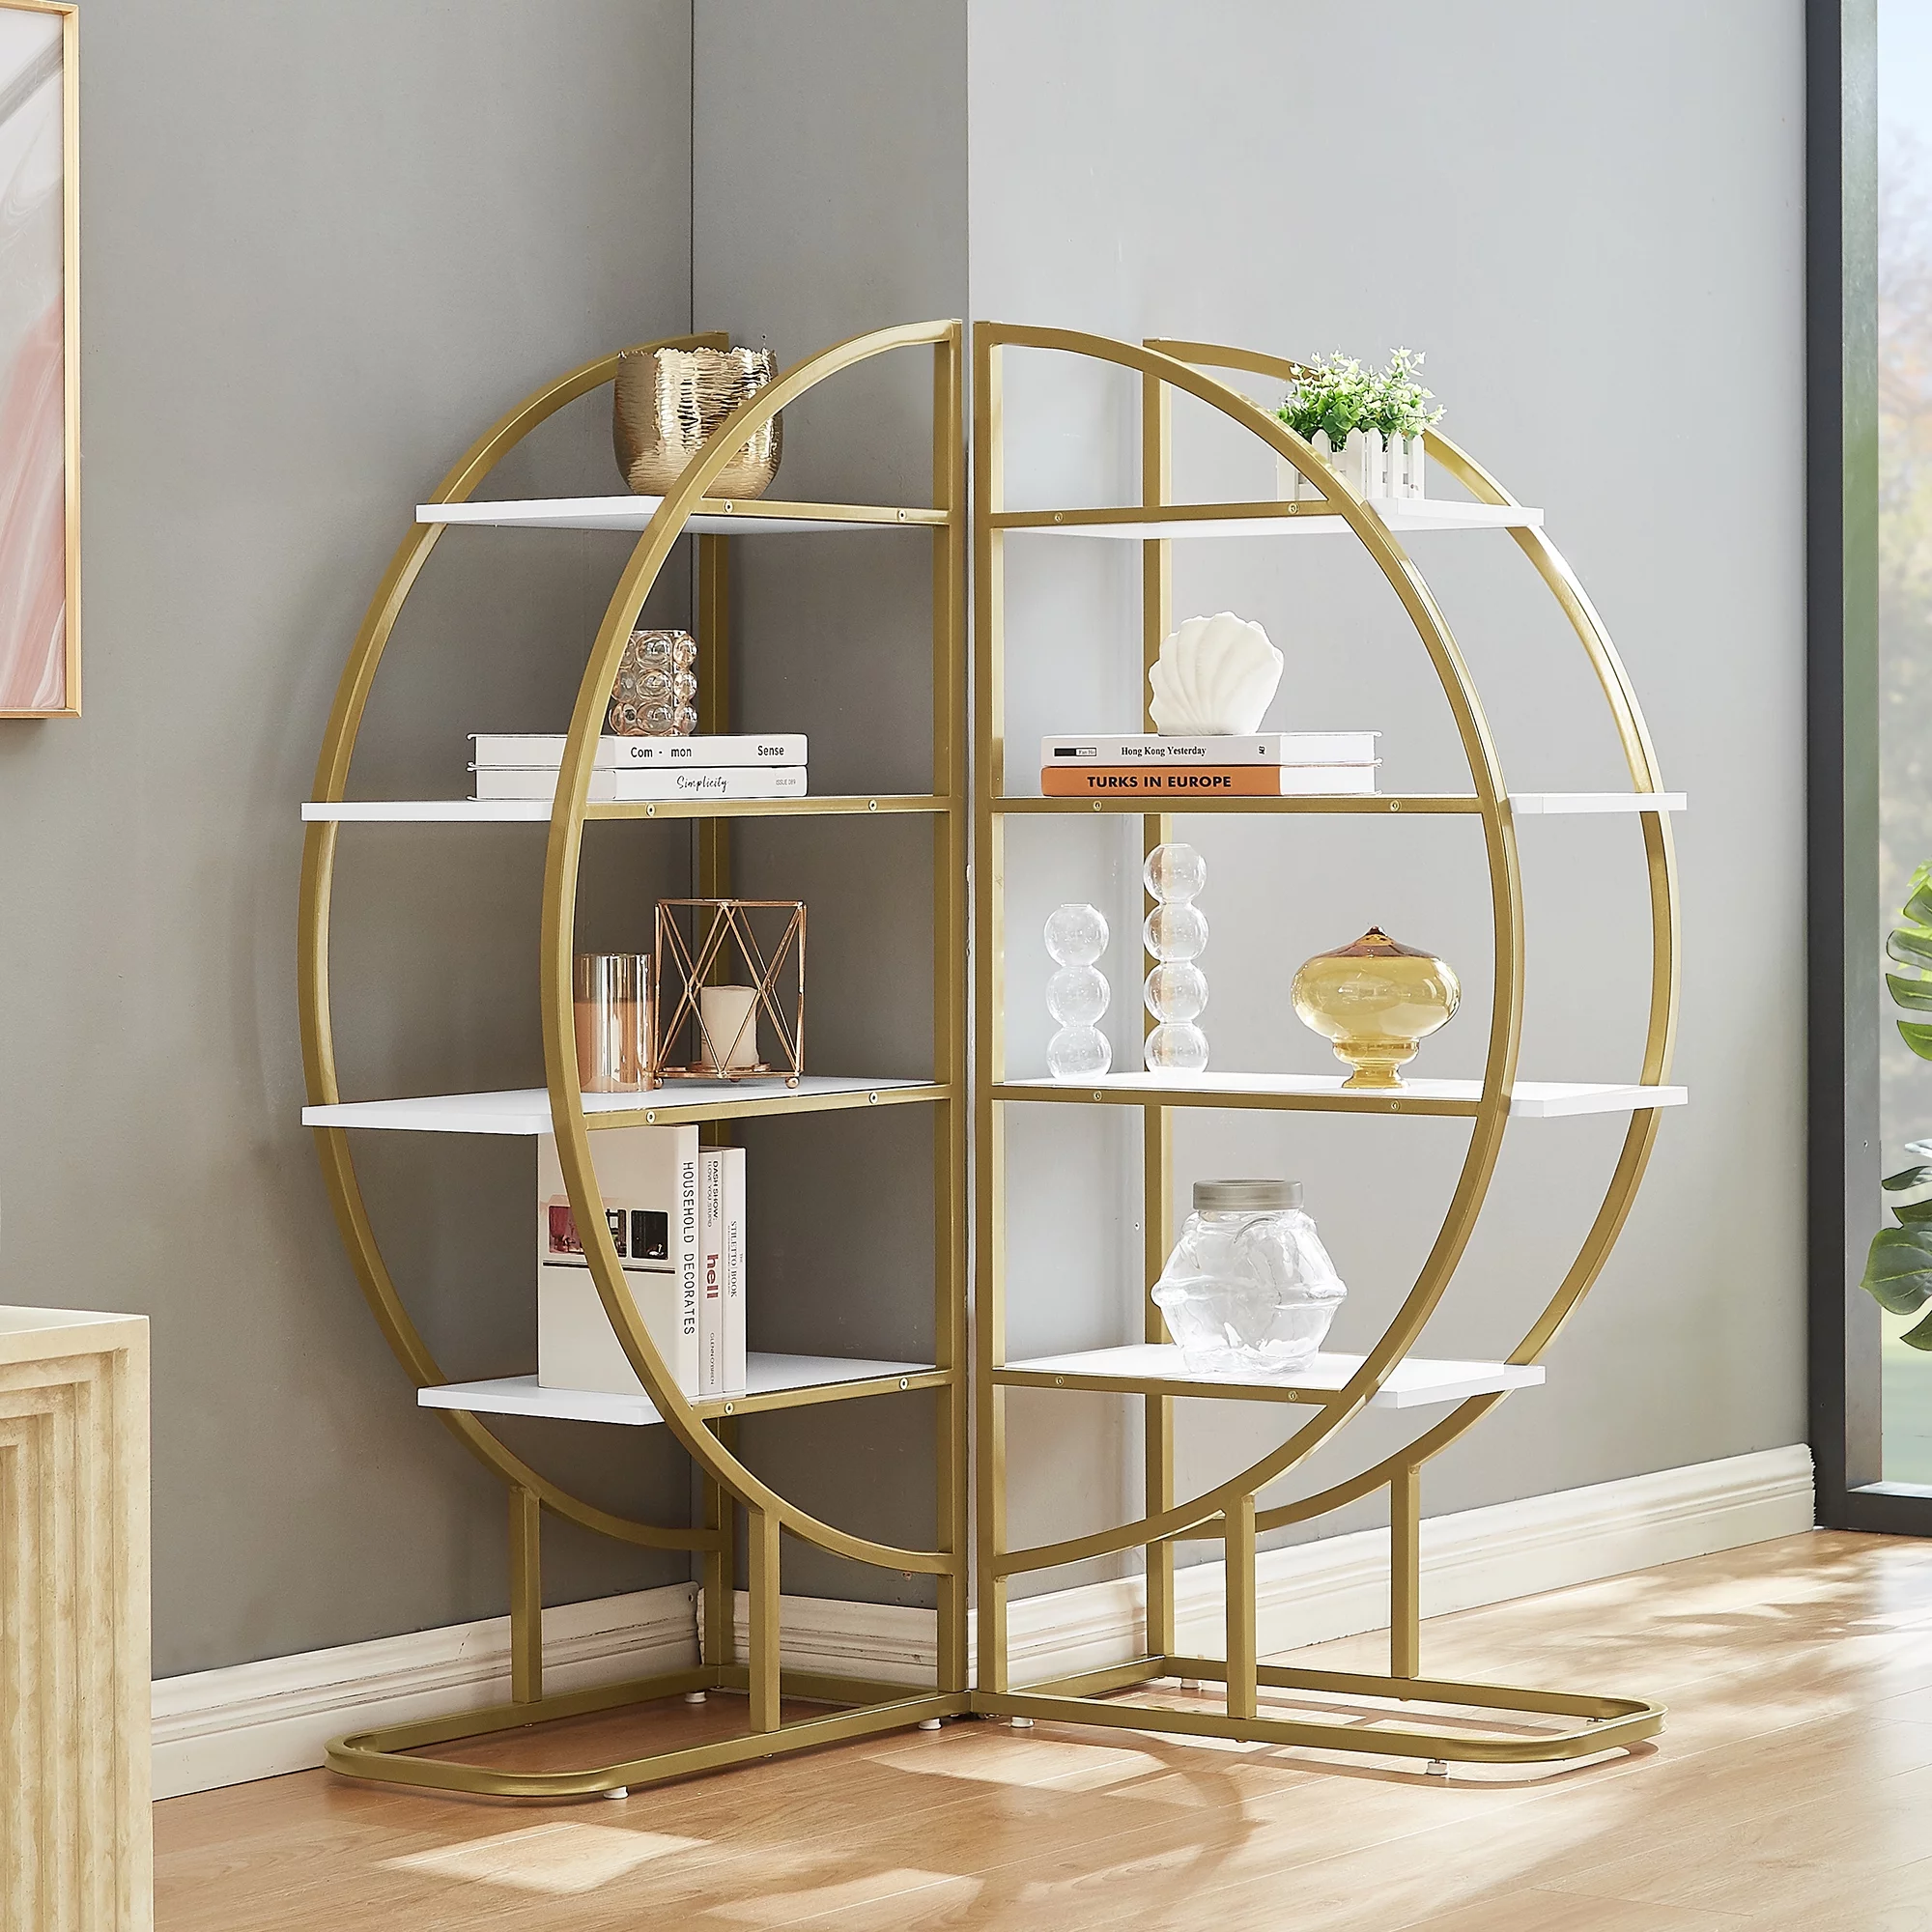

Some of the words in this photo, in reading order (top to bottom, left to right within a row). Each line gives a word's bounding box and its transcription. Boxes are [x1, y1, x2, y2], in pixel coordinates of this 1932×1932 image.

[630, 746, 653, 758] Com
[670, 748, 693, 758] mon
[757, 745, 785, 756] Sense
[1121, 747, 1143, 757] Hong
[1144, 747, 1166, 757] Kong
[1167, 746, 1208, 757] Yesterday
[675, 776, 729, 793] Simplicity
[1087, 776, 1139, 788] TURKS
[1144, 776, 1162, 788] IN
[1168, 776, 1232, 788] EUROPE
[682, 1161, 695, 1243] HOUSEHOLD
[706, 1254, 719, 1299] hell
[683, 1253, 696, 1336] DECORATES
